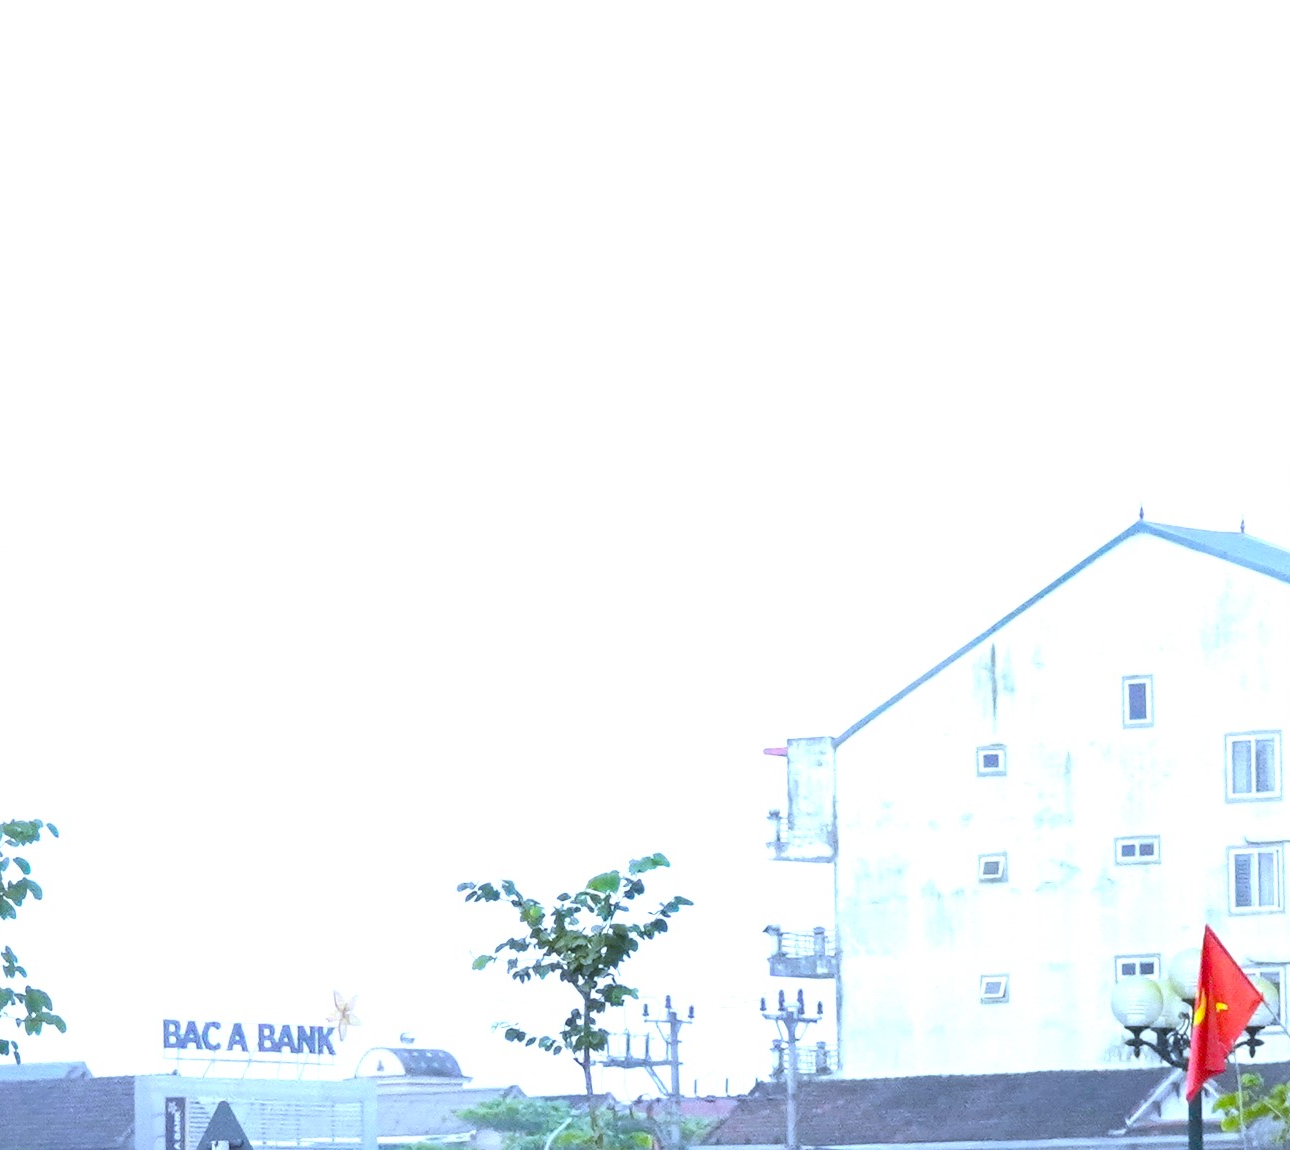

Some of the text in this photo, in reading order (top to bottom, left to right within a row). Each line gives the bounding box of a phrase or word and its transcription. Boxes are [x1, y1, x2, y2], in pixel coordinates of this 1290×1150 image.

[163, 1019, 336, 1055] BAC A BANK
